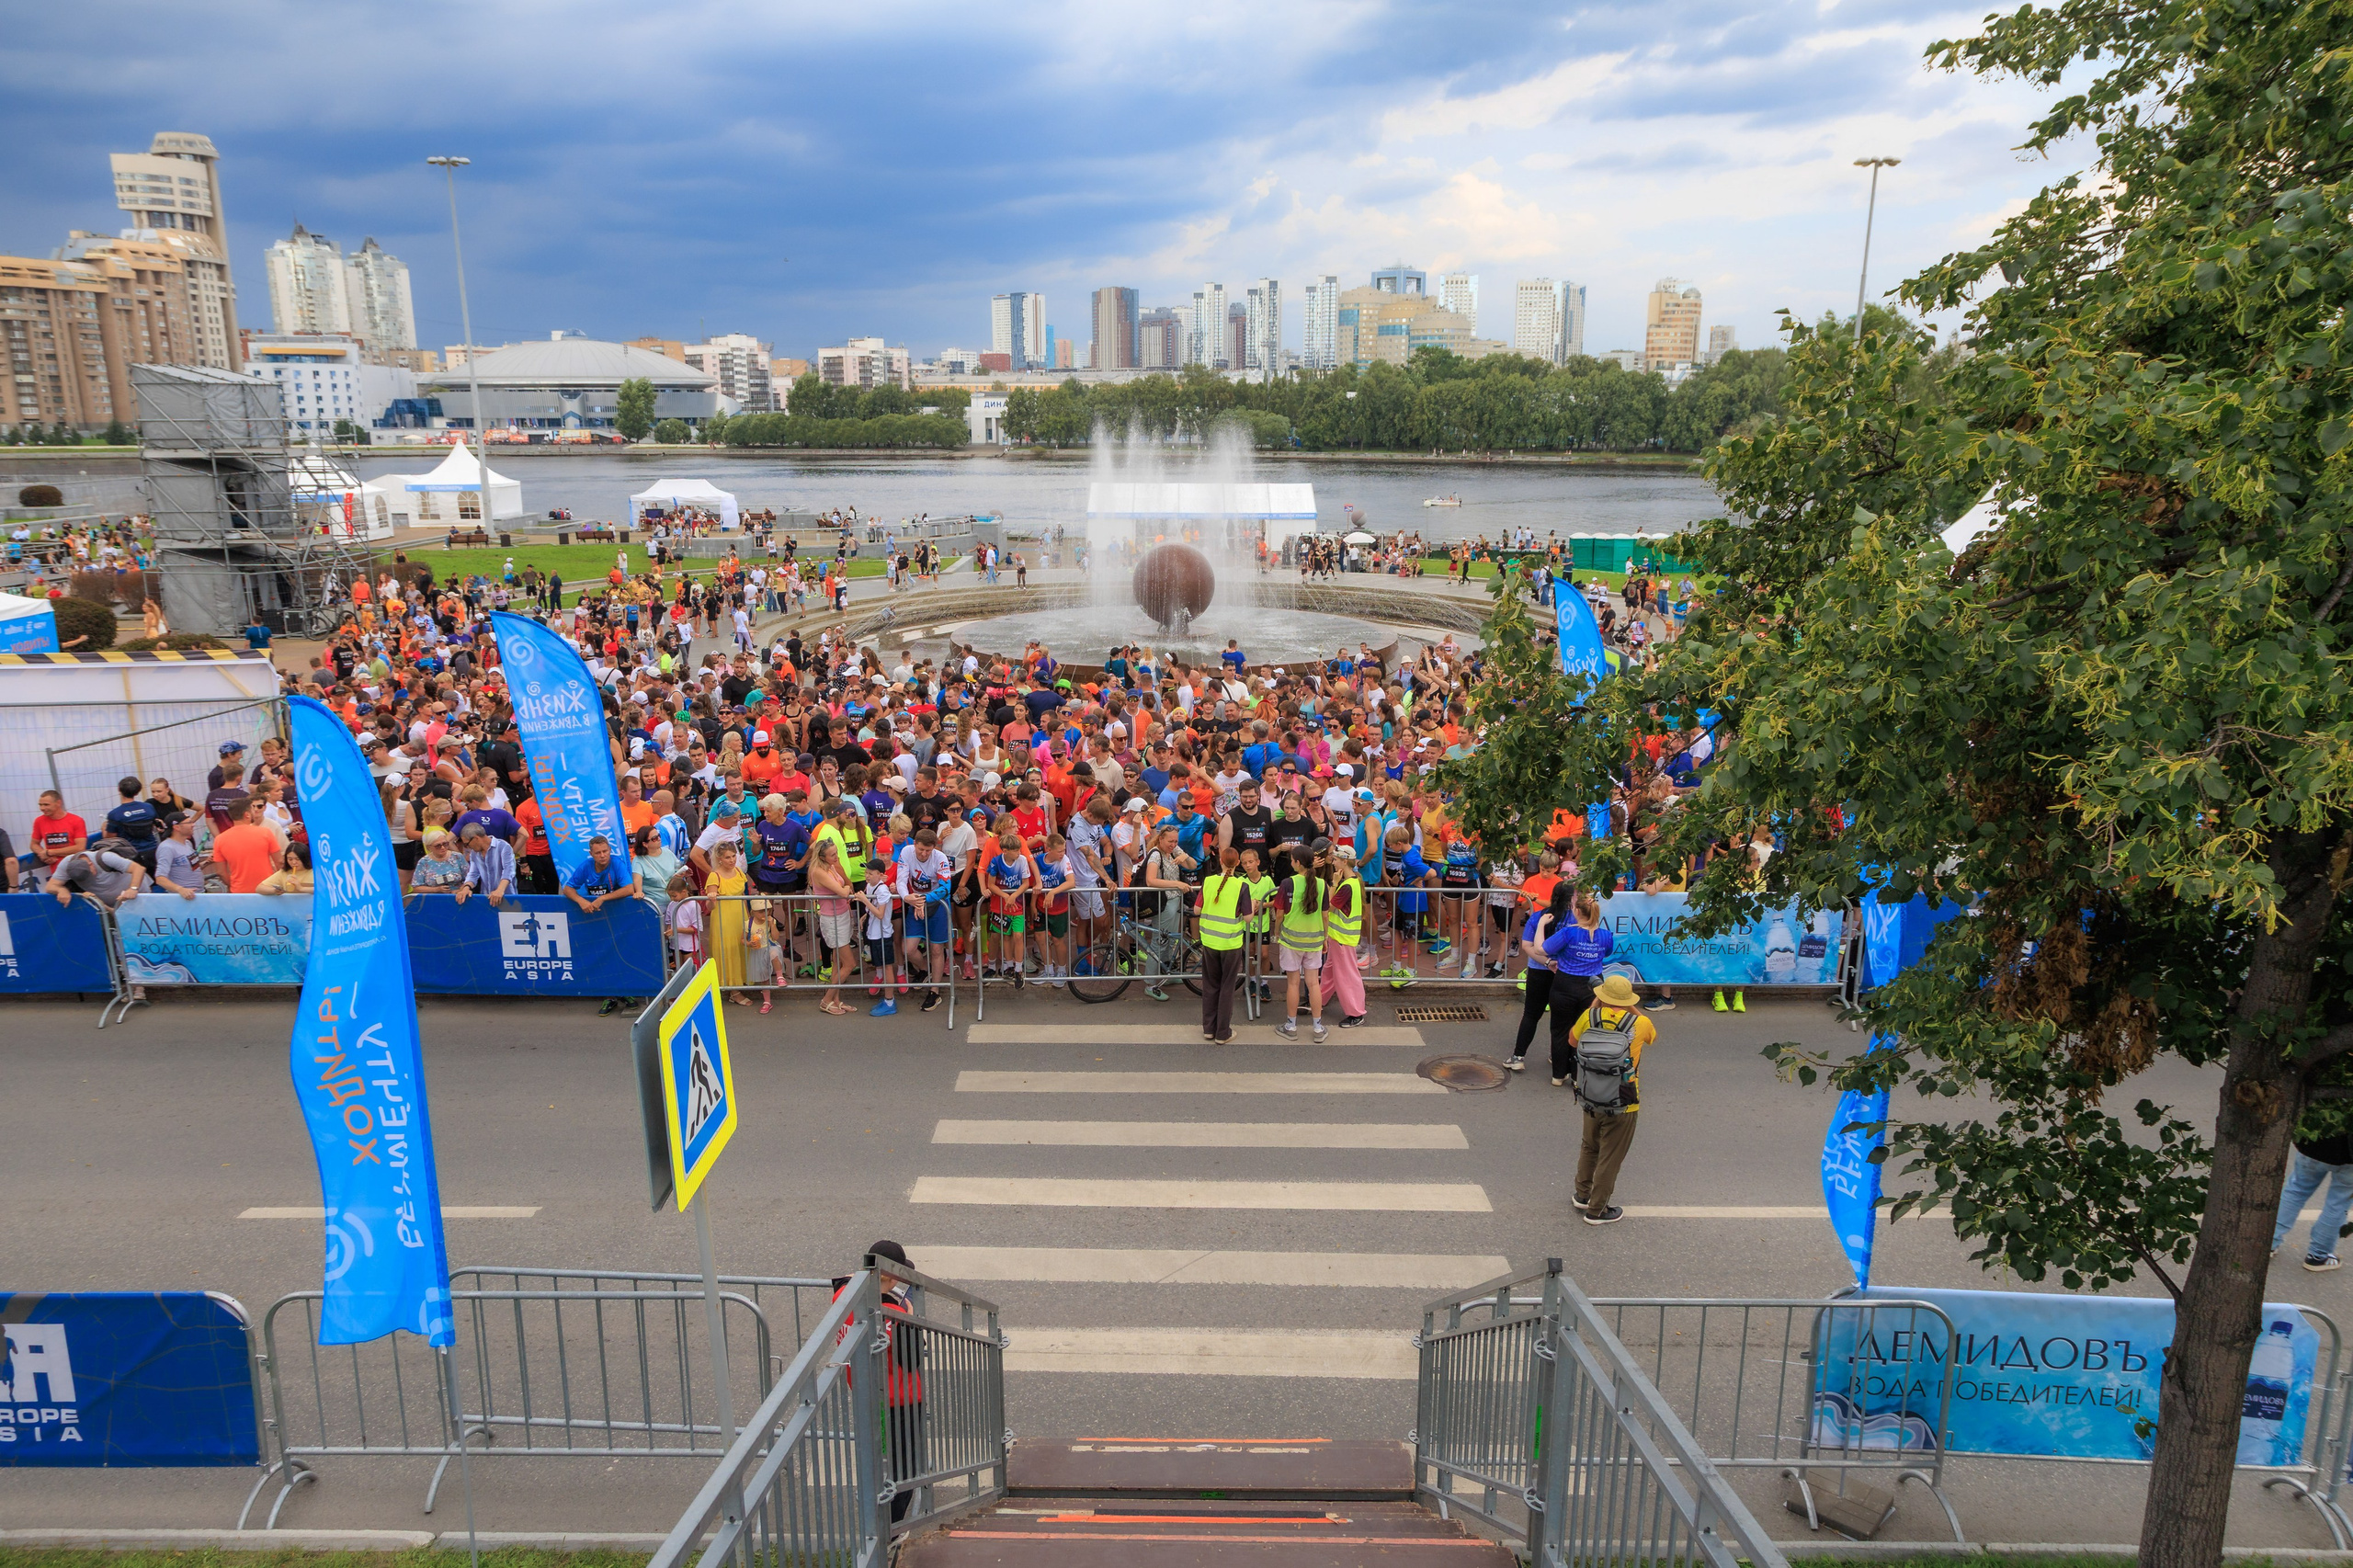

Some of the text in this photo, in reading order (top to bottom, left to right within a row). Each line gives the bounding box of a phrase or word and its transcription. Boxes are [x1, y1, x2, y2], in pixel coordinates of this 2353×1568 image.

[10, 637, 51, 653] ХОДИТЬ!
[137, 917, 290, 938] ДЕМИДОВЪ
[141, 940, 292, 957] ВОДА ПОБЕДИТЕЛЕЙ!
[1641, 941, 1750, 958] ПОБЕДИТЕЛЕЙ!
[504, 960, 574, 971] EUROPE
[1848, 1330, 2148, 1374] ДЕМИДОВЪ
[1848, 1375, 2142, 1409] ВОДА ПОБЕДИТЕЛЕЙ!
[2244, 1393, 2285, 1405] ЕМИДОВЪ
